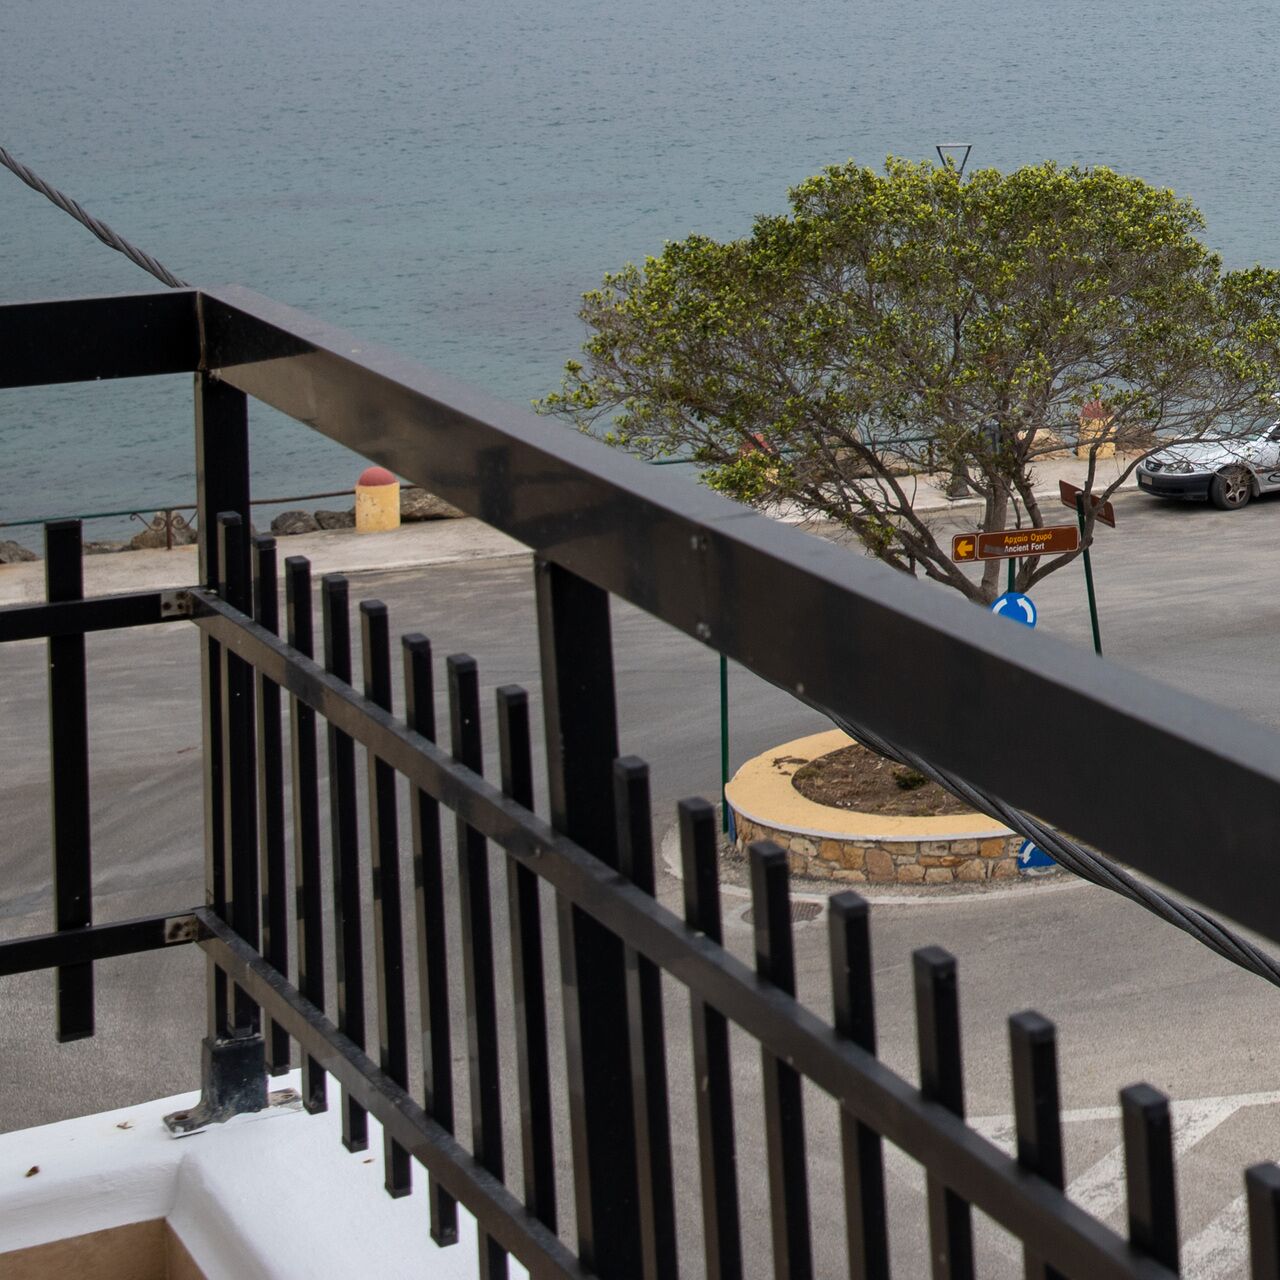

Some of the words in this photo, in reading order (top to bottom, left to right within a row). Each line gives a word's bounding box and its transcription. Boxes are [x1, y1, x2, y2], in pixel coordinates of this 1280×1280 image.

[1004, 533, 1028, 544] Αρχαίο
[1030, 531, 1052, 542] Οχυρό
[1004, 544, 1029, 552] Ancient
[1031, 542, 1045, 551] Fort
